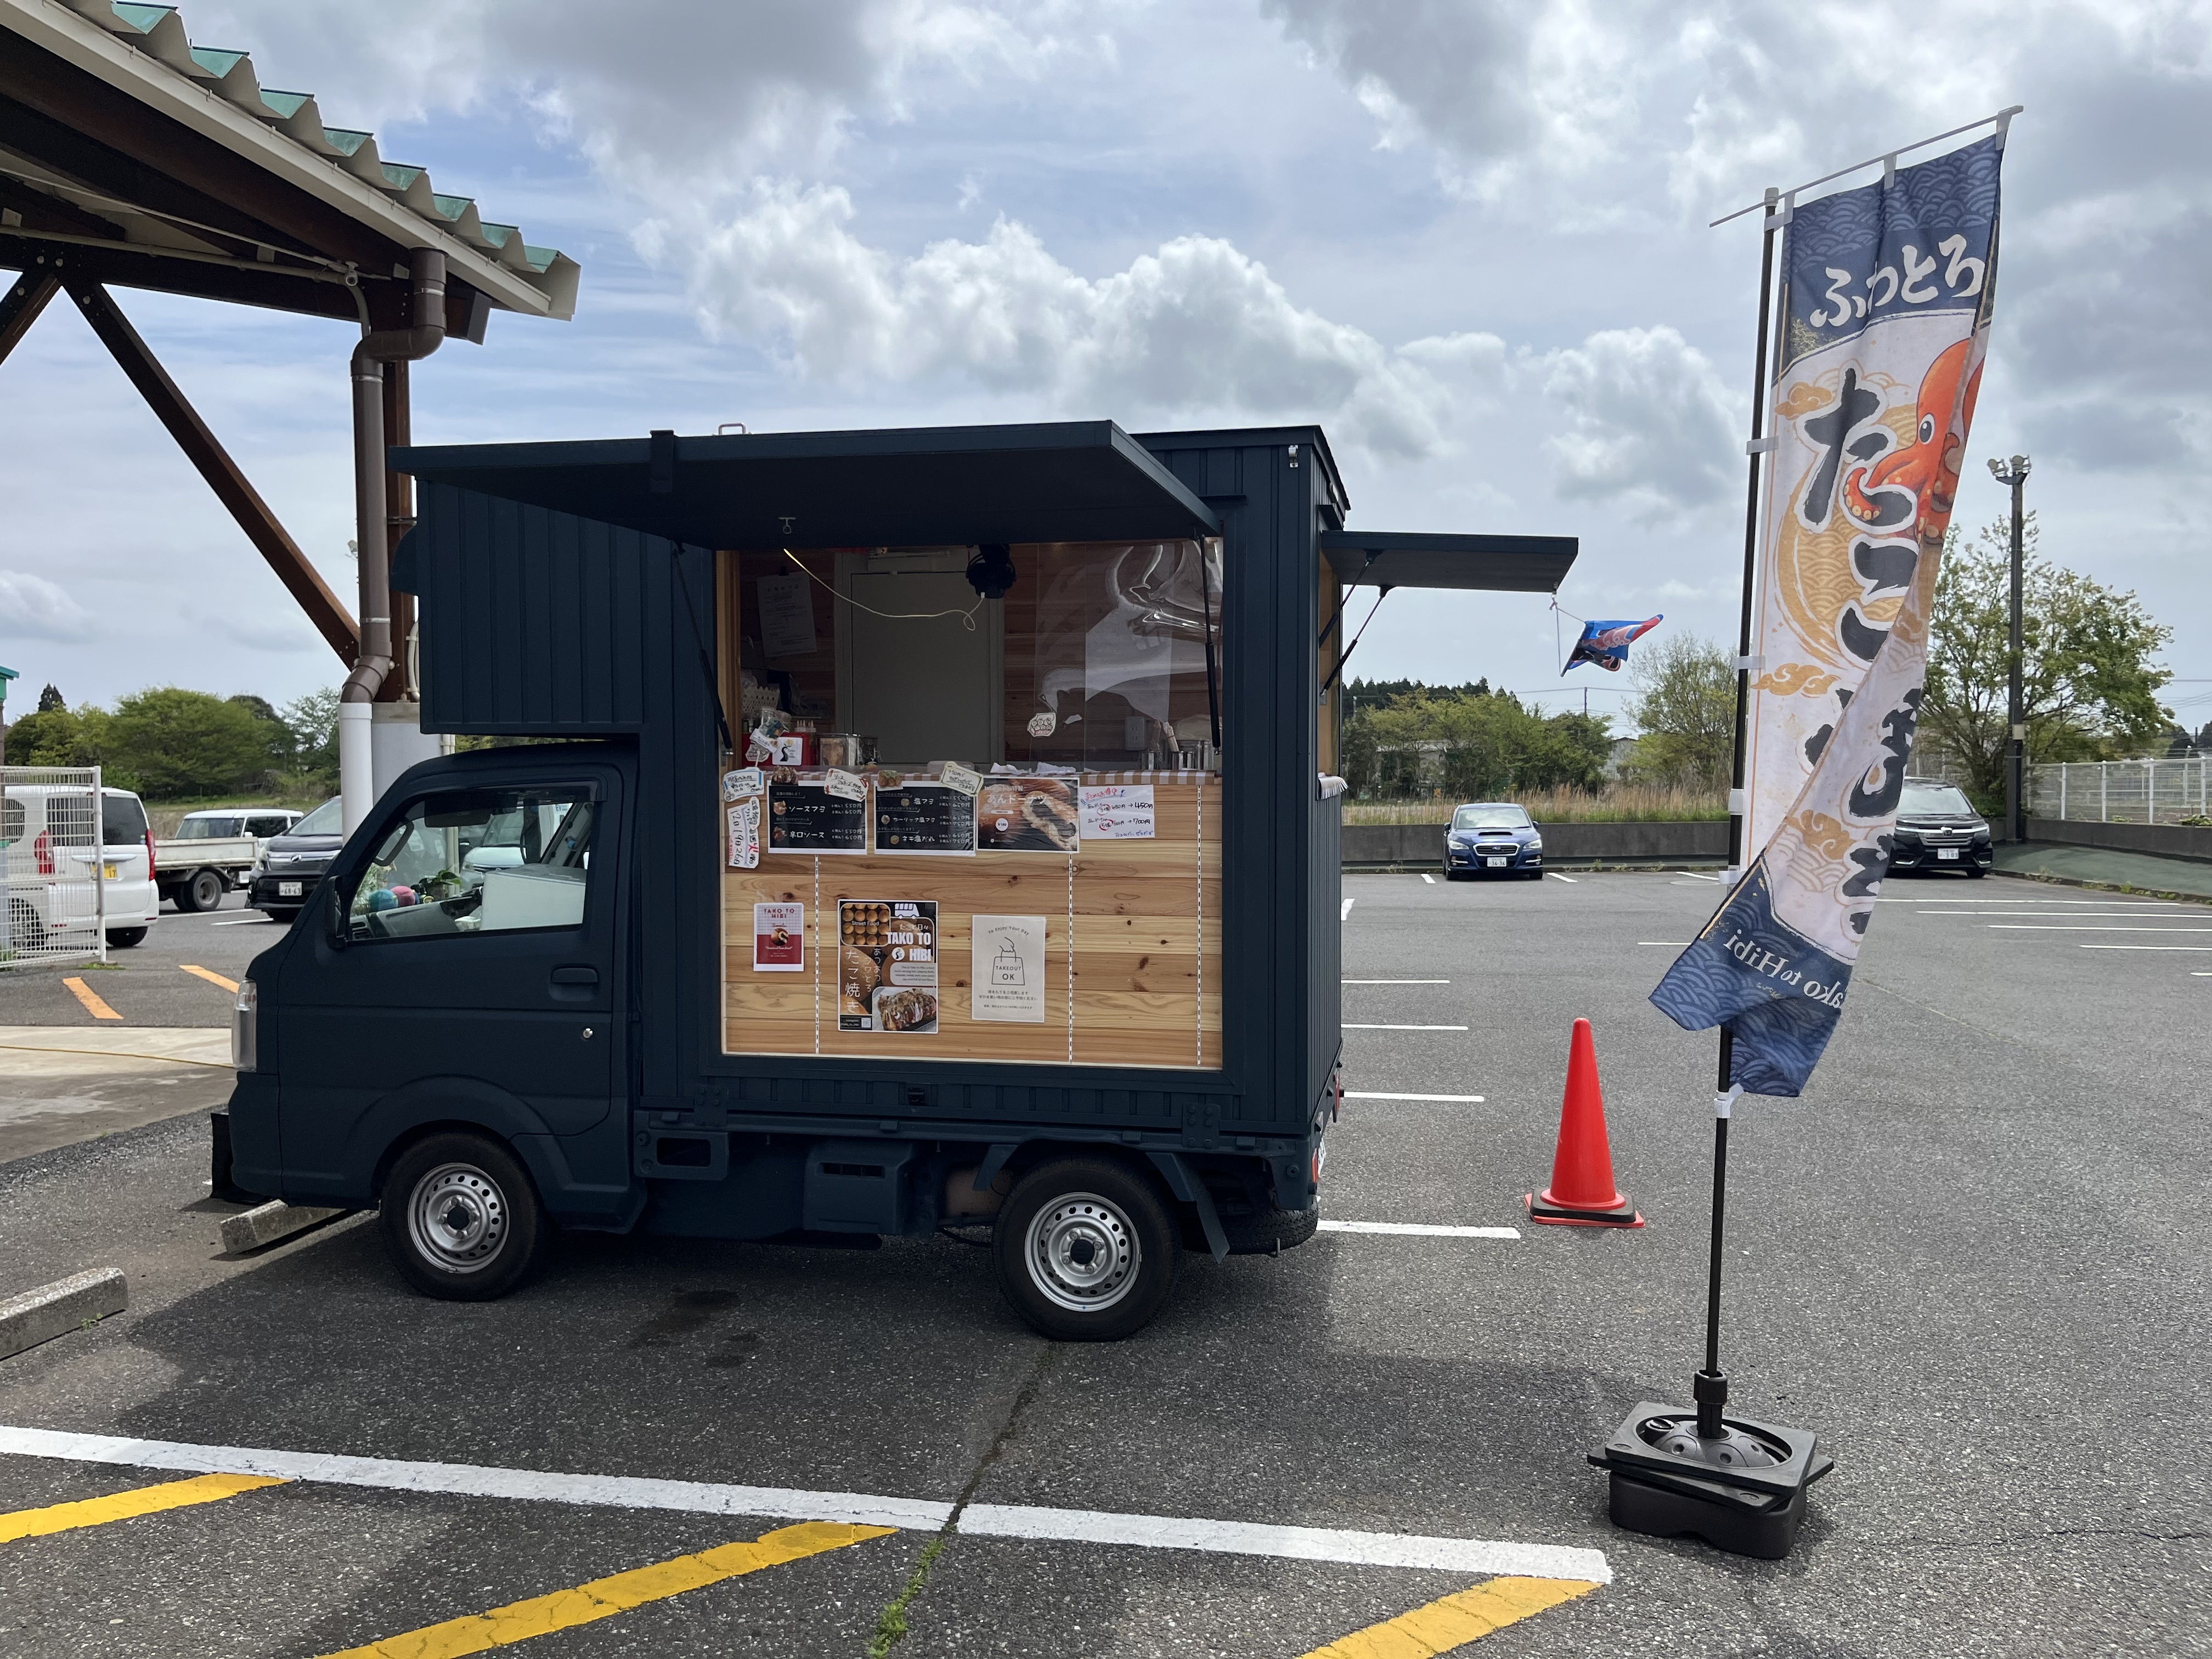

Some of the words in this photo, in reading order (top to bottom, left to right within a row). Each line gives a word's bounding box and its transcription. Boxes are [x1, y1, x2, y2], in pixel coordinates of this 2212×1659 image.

[1810, 234, 1985, 328] ふわとろ
[988, 794, 1047, 804] あんドーナツ
[886, 932, 914, 945] TAKO
[917, 932, 932, 945] TO
[909, 948, 932, 961] HIBI
[845, 950, 860, 1013] たこ焼き
